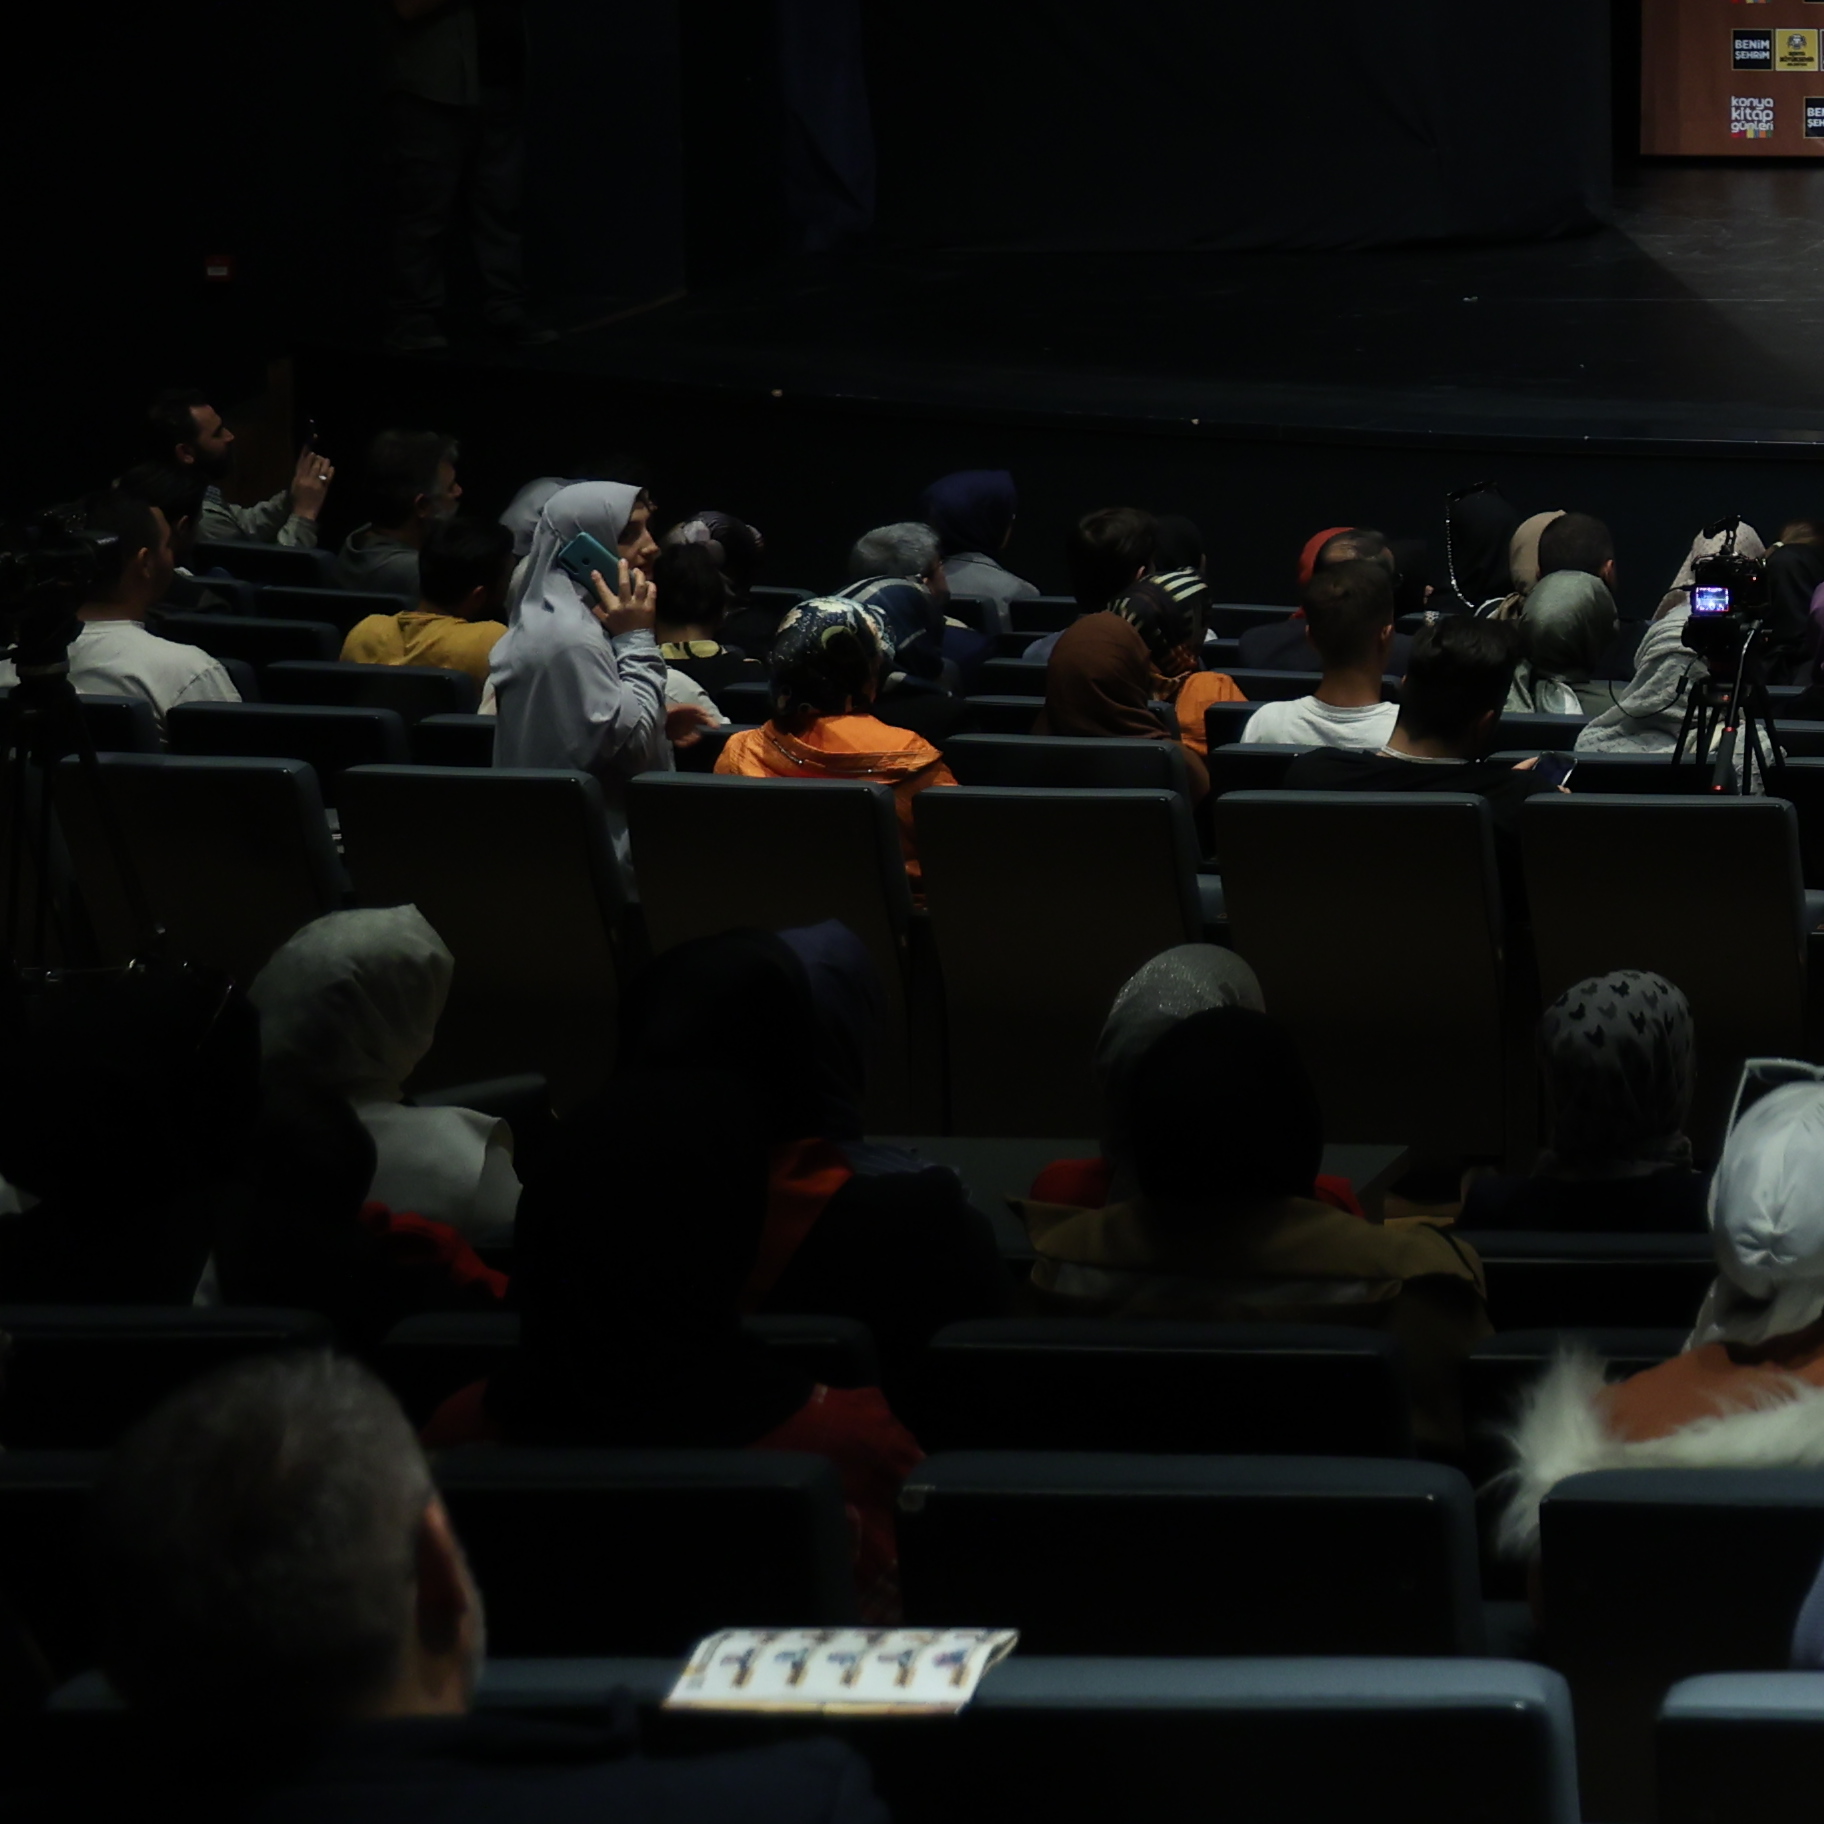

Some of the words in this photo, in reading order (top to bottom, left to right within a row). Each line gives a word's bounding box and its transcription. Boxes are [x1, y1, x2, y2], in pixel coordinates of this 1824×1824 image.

[1730, 96, 1774, 110] konya
[1730, 109, 1774, 123] kitap
[1730, 122, 1774, 134] günleri
